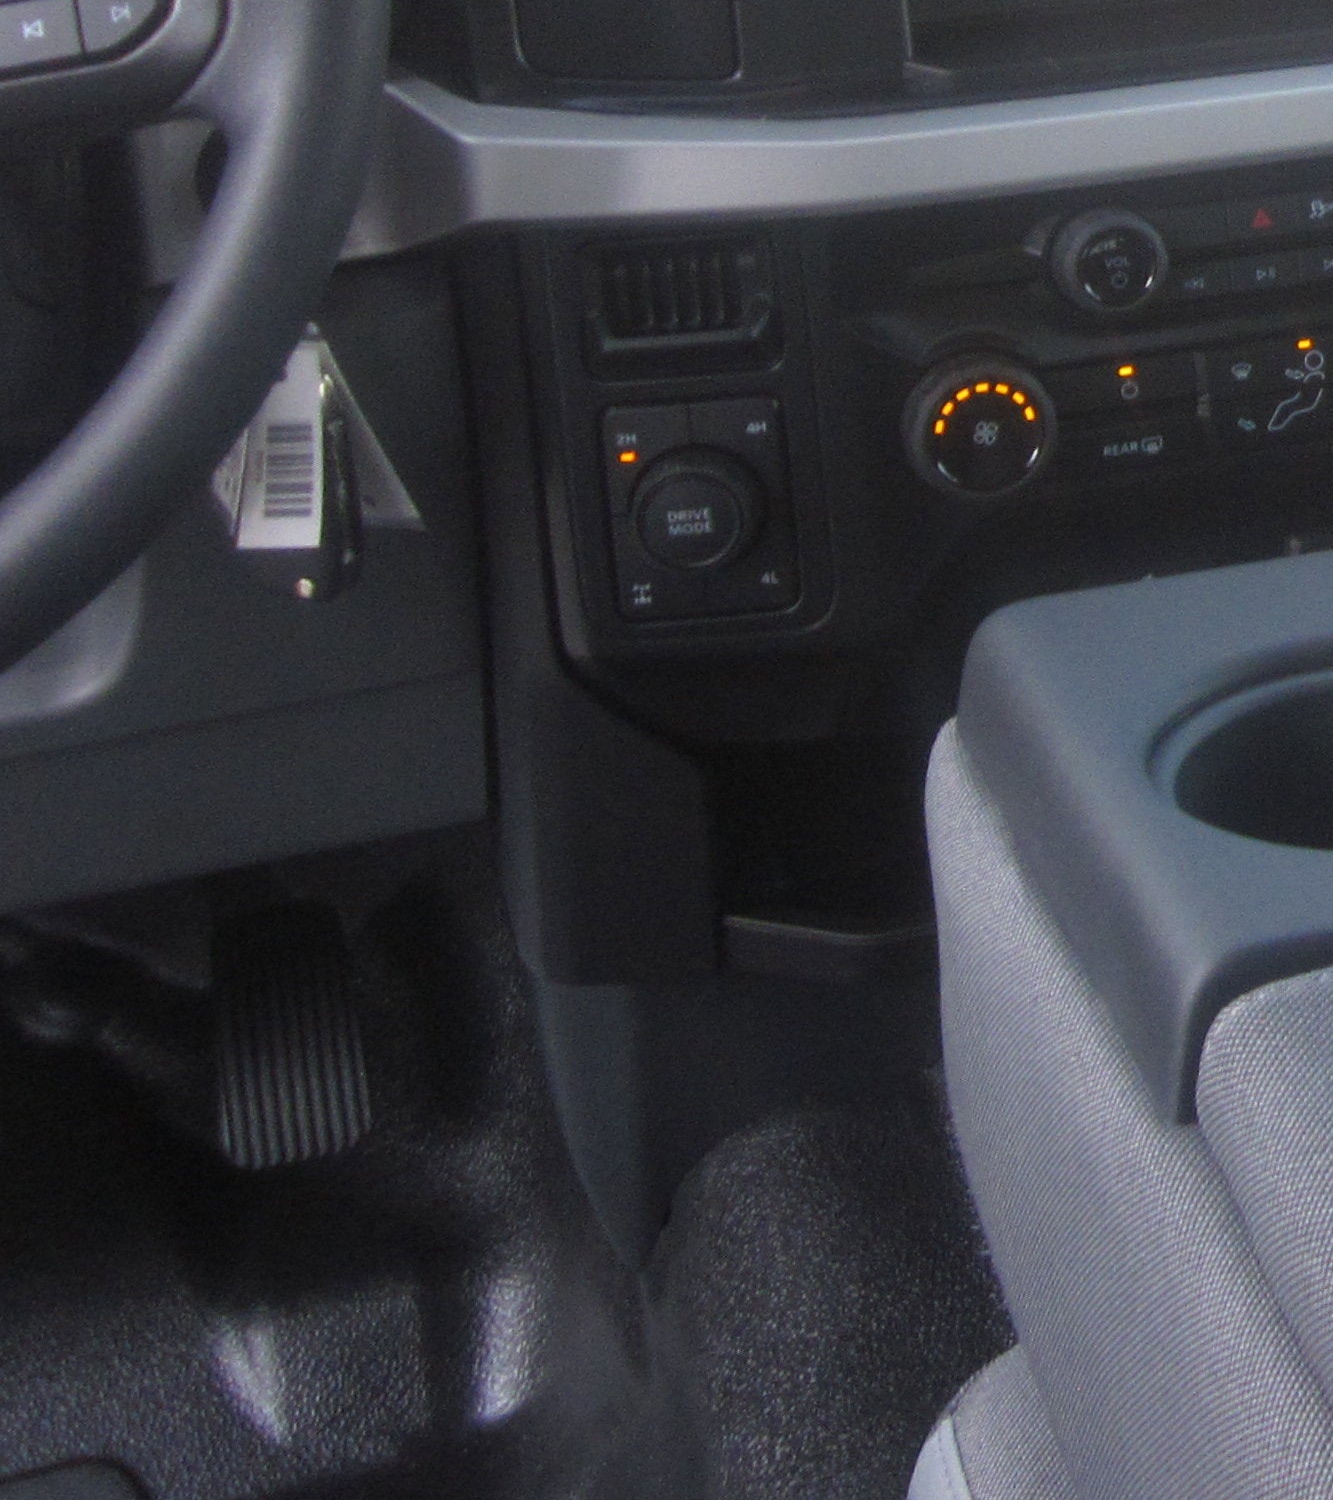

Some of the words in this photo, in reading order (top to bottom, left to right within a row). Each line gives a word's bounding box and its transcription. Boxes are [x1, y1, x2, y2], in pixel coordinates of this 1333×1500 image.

[1104, 255, 1129, 268] VOL
[745, 421, 767, 434] 4H
[616, 433, 637, 445] 2H
[1103, 441, 1139, 457] REAR
[666, 507, 712, 523] DRIVE
[667, 520, 713, 536] MODE
[760, 571, 779, 584] 4L
